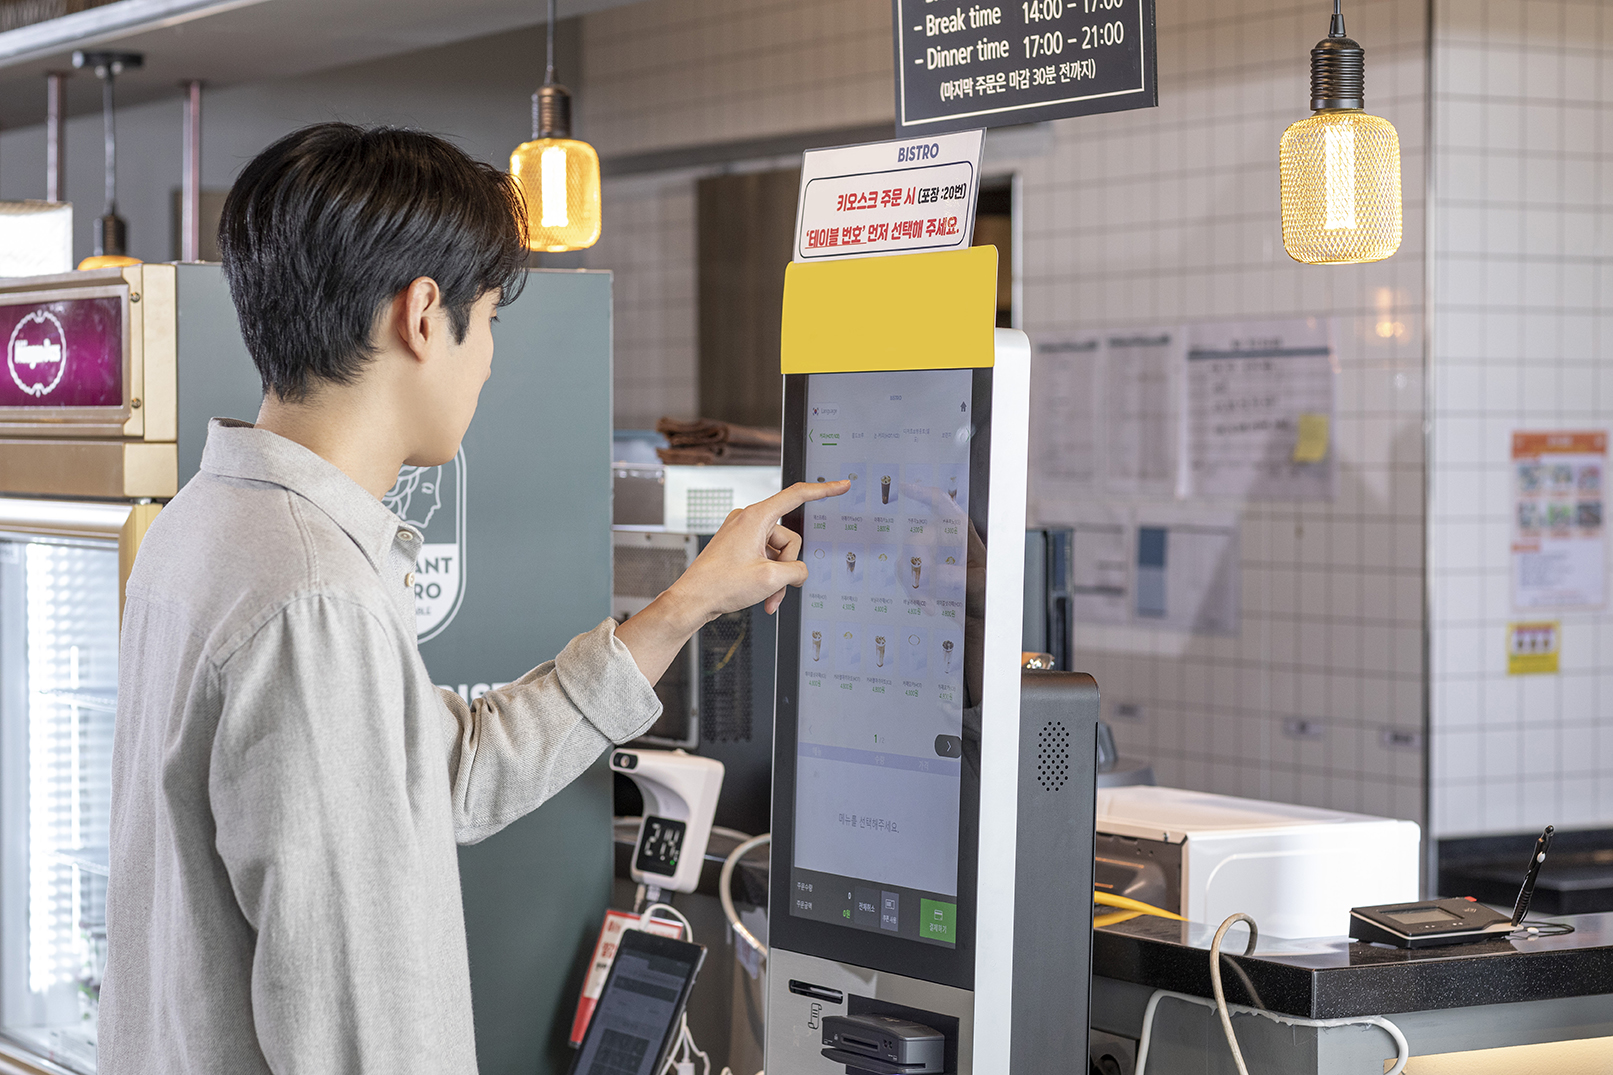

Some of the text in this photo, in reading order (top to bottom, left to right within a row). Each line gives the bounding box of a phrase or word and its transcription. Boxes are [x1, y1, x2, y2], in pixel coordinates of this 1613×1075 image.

[926, 7, 966, 36] Break
[969, 5, 1001, 28] time
[1022, 0, 1063, 24] 14:00
[927, 46, 974, 70] Dinner
[976, 38, 1009, 61] time
[1023, 31, 1063, 59] 17:00
[1082, 21, 1124, 49] 21:00
[940, 58, 1096, 102] (마지막 주문은 마감 30분 전까지)
[898, 143, 939, 162] BISTRO
[836, 191, 878, 212] 키오스크
[880, 188, 902, 208] 주문
[904, 187, 916, 205] 시
[918, 188, 939, 204] (포장
[806, 216, 960, 248] ‘테이블 번호’ 먼저 선택해 주세요.
[838, 813, 900, 834] 메뉴를 선택해주세요.
